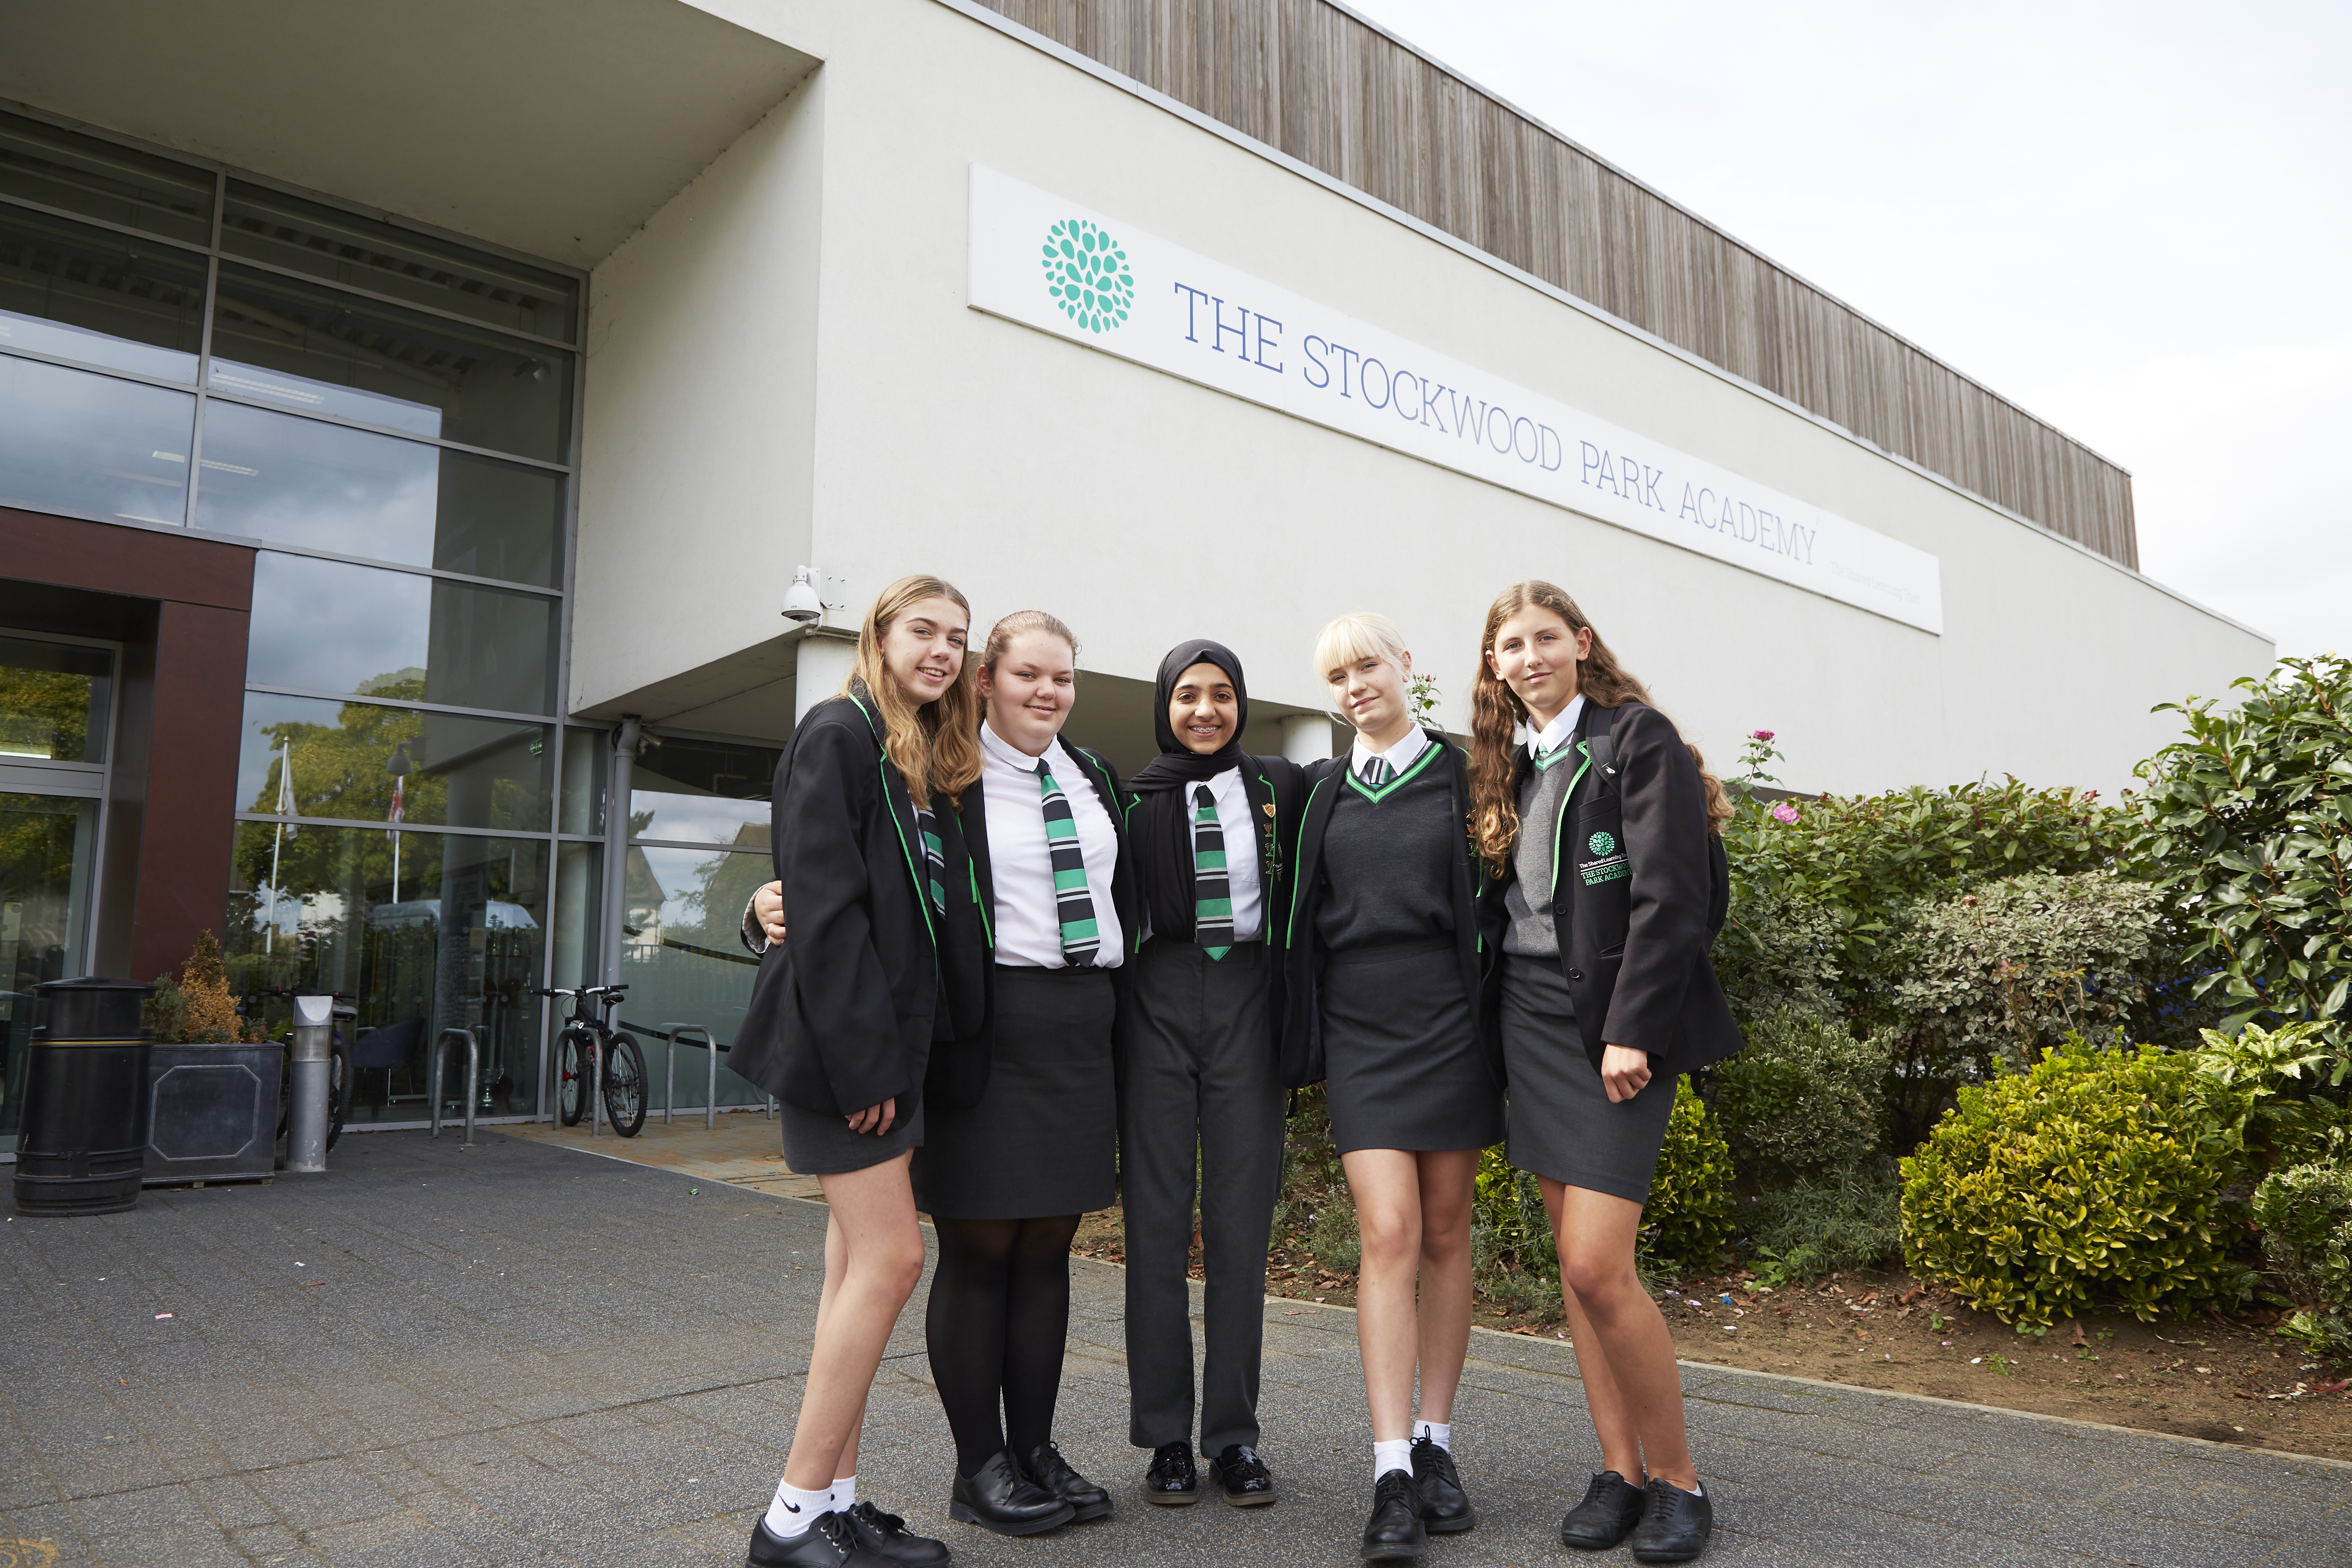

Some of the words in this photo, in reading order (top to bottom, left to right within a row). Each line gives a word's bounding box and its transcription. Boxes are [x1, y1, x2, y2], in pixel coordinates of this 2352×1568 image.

[1174, 282, 1283, 374] THE
[1303, 335, 1561, 471] STOCKWOOD
[1580, 440, 1665, 512] PARK
[1679, 481, 1816, 565] ACADEMY
[1830, 561, 1844, 577] The
[1846, 567, 1871, 587] Shared
[1872, 576, 1902, 601] Learning
[1903, 588, 1920, 605] Trust
[1588, 858, 1604, 866] Shared
[1581, 870, 1596, 879] THE
[1585, 875, 1604, 886] PARK
[1604, 868, 1633, 881] ACADEMY
